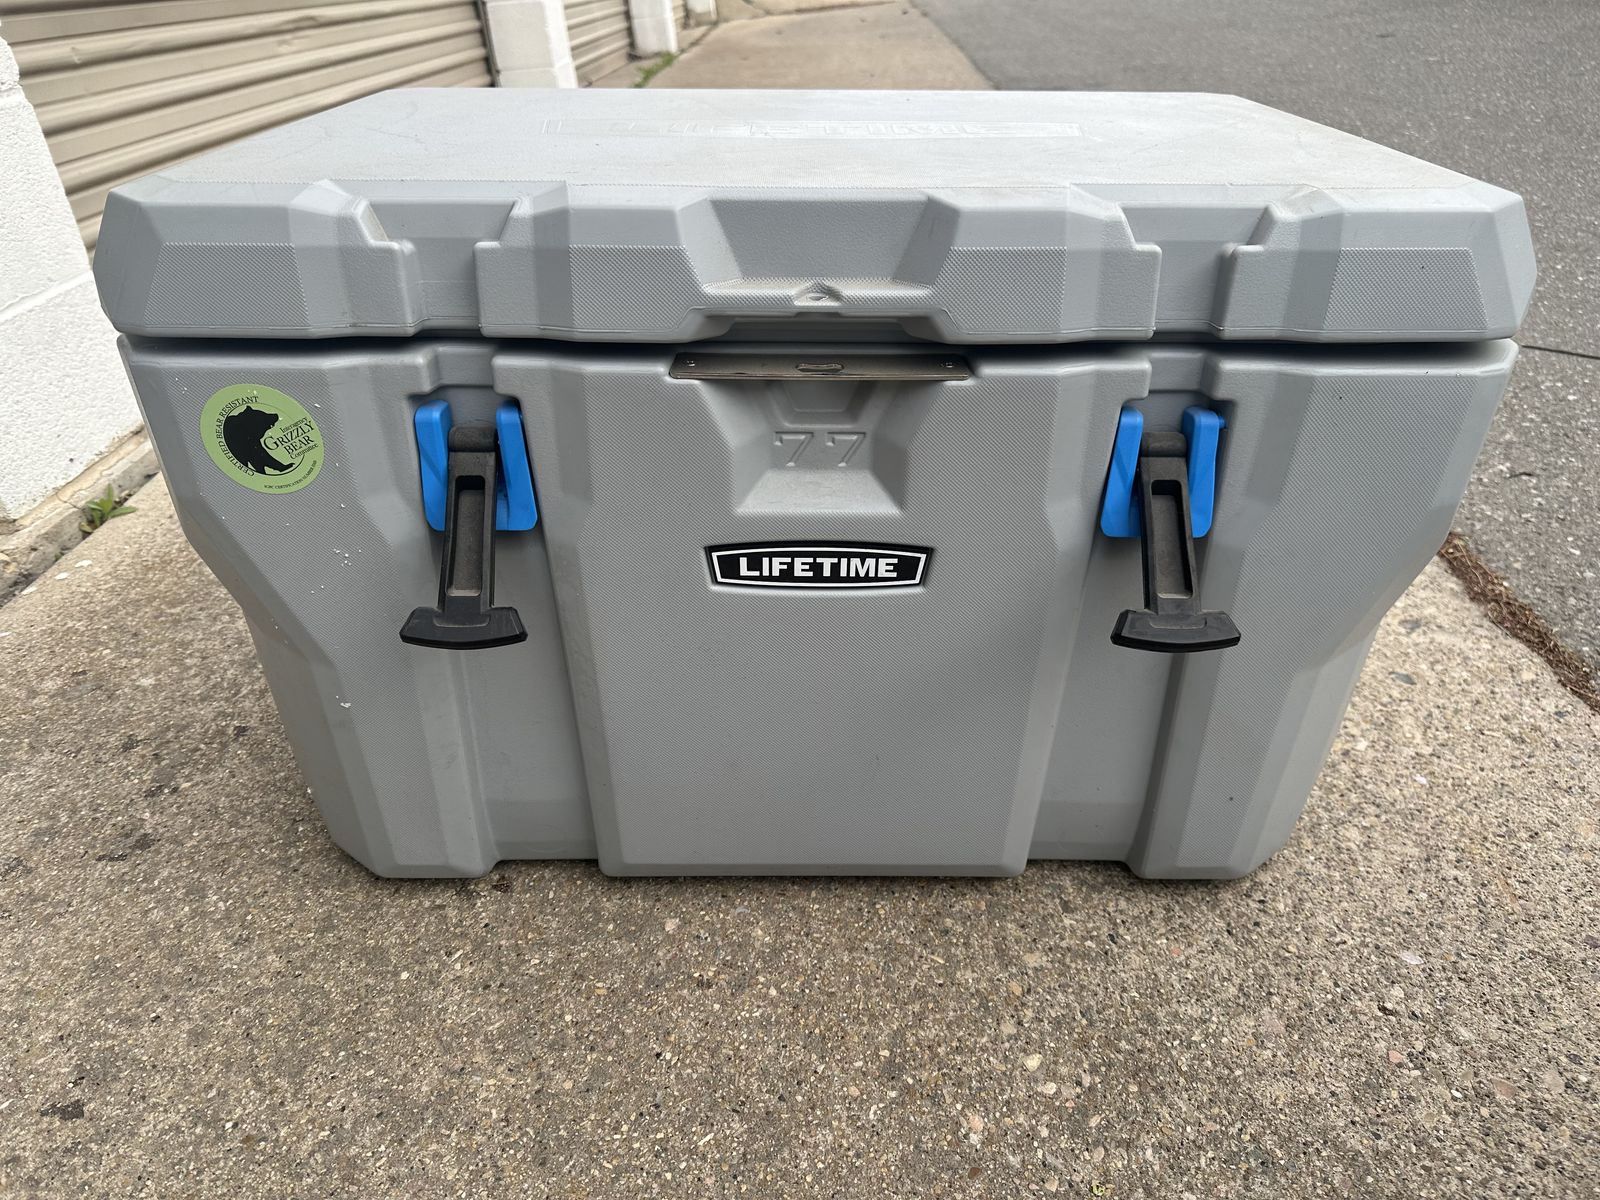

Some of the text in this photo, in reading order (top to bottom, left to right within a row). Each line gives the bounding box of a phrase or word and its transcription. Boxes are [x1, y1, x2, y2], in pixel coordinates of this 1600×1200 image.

[215, 396, 259, 477] CERTIFIED BEAR RESISTANT
[283, 435, 314, 454] BEAR
[739, 557, 899, 578] LIFETIME
